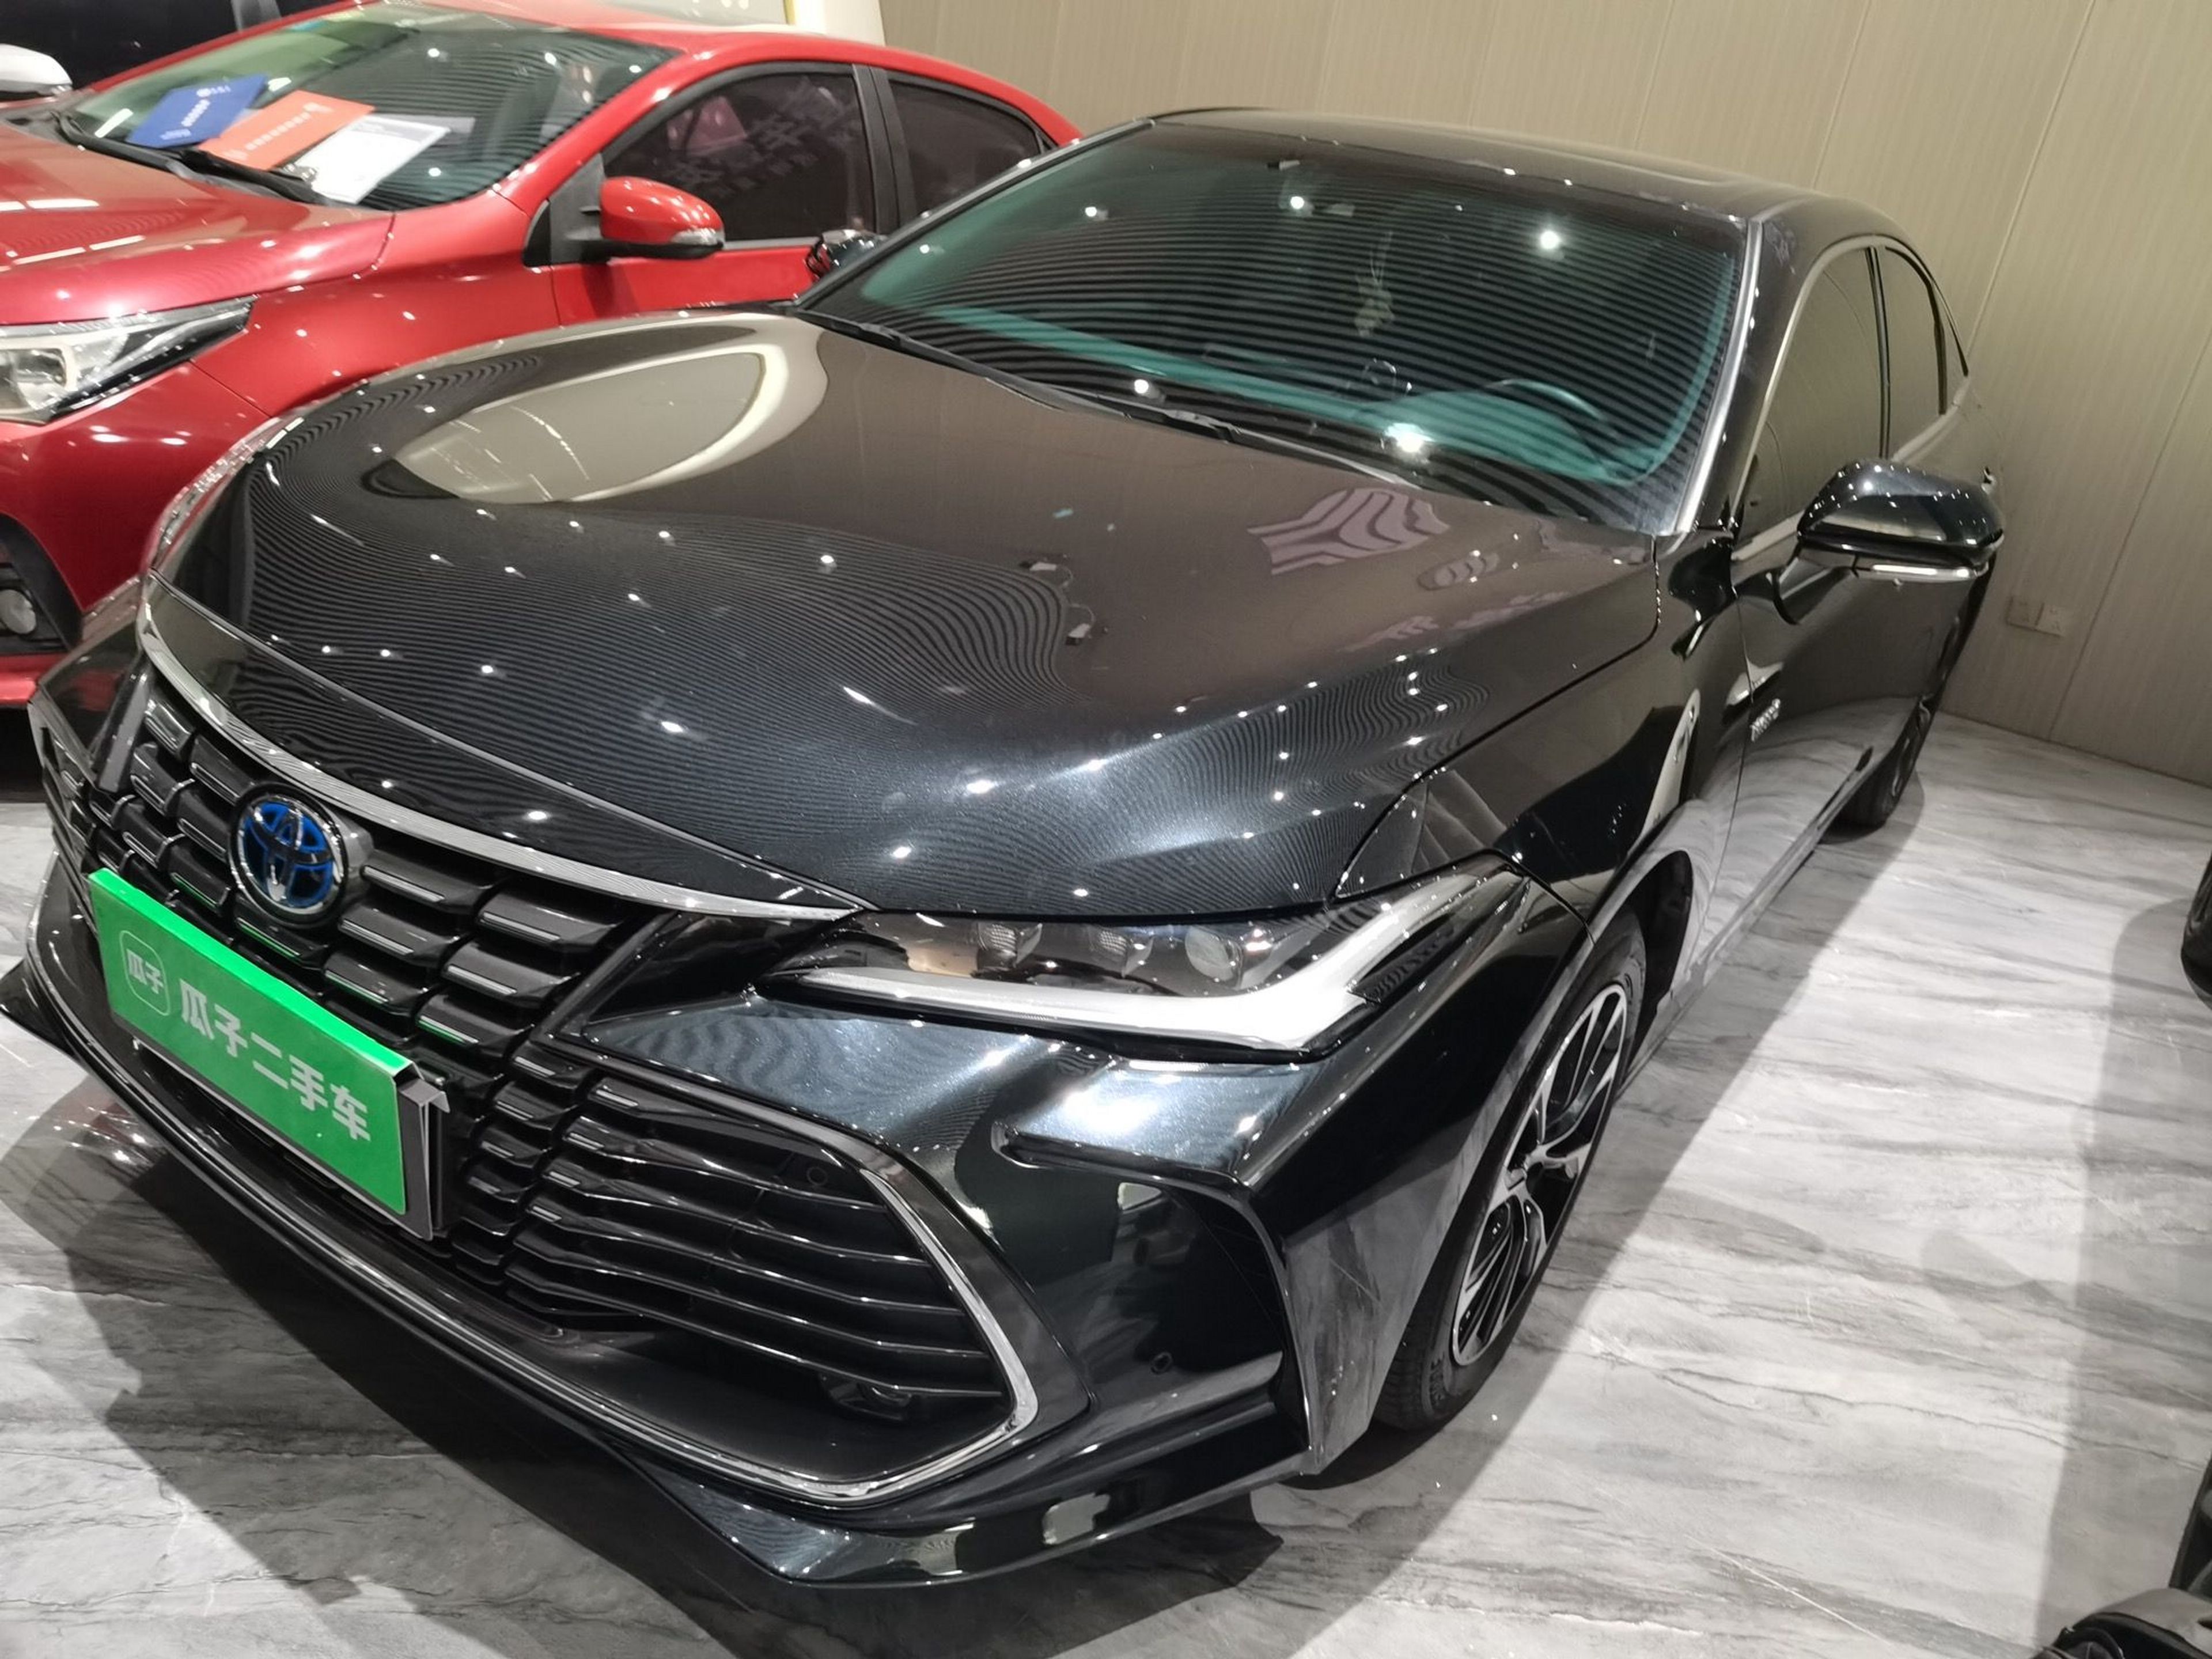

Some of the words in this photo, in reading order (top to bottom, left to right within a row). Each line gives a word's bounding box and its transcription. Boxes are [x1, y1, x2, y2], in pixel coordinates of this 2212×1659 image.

[126, 949, 164, 994] 瓜子
[180, 978, 371, 1142] 瓜子二手车
